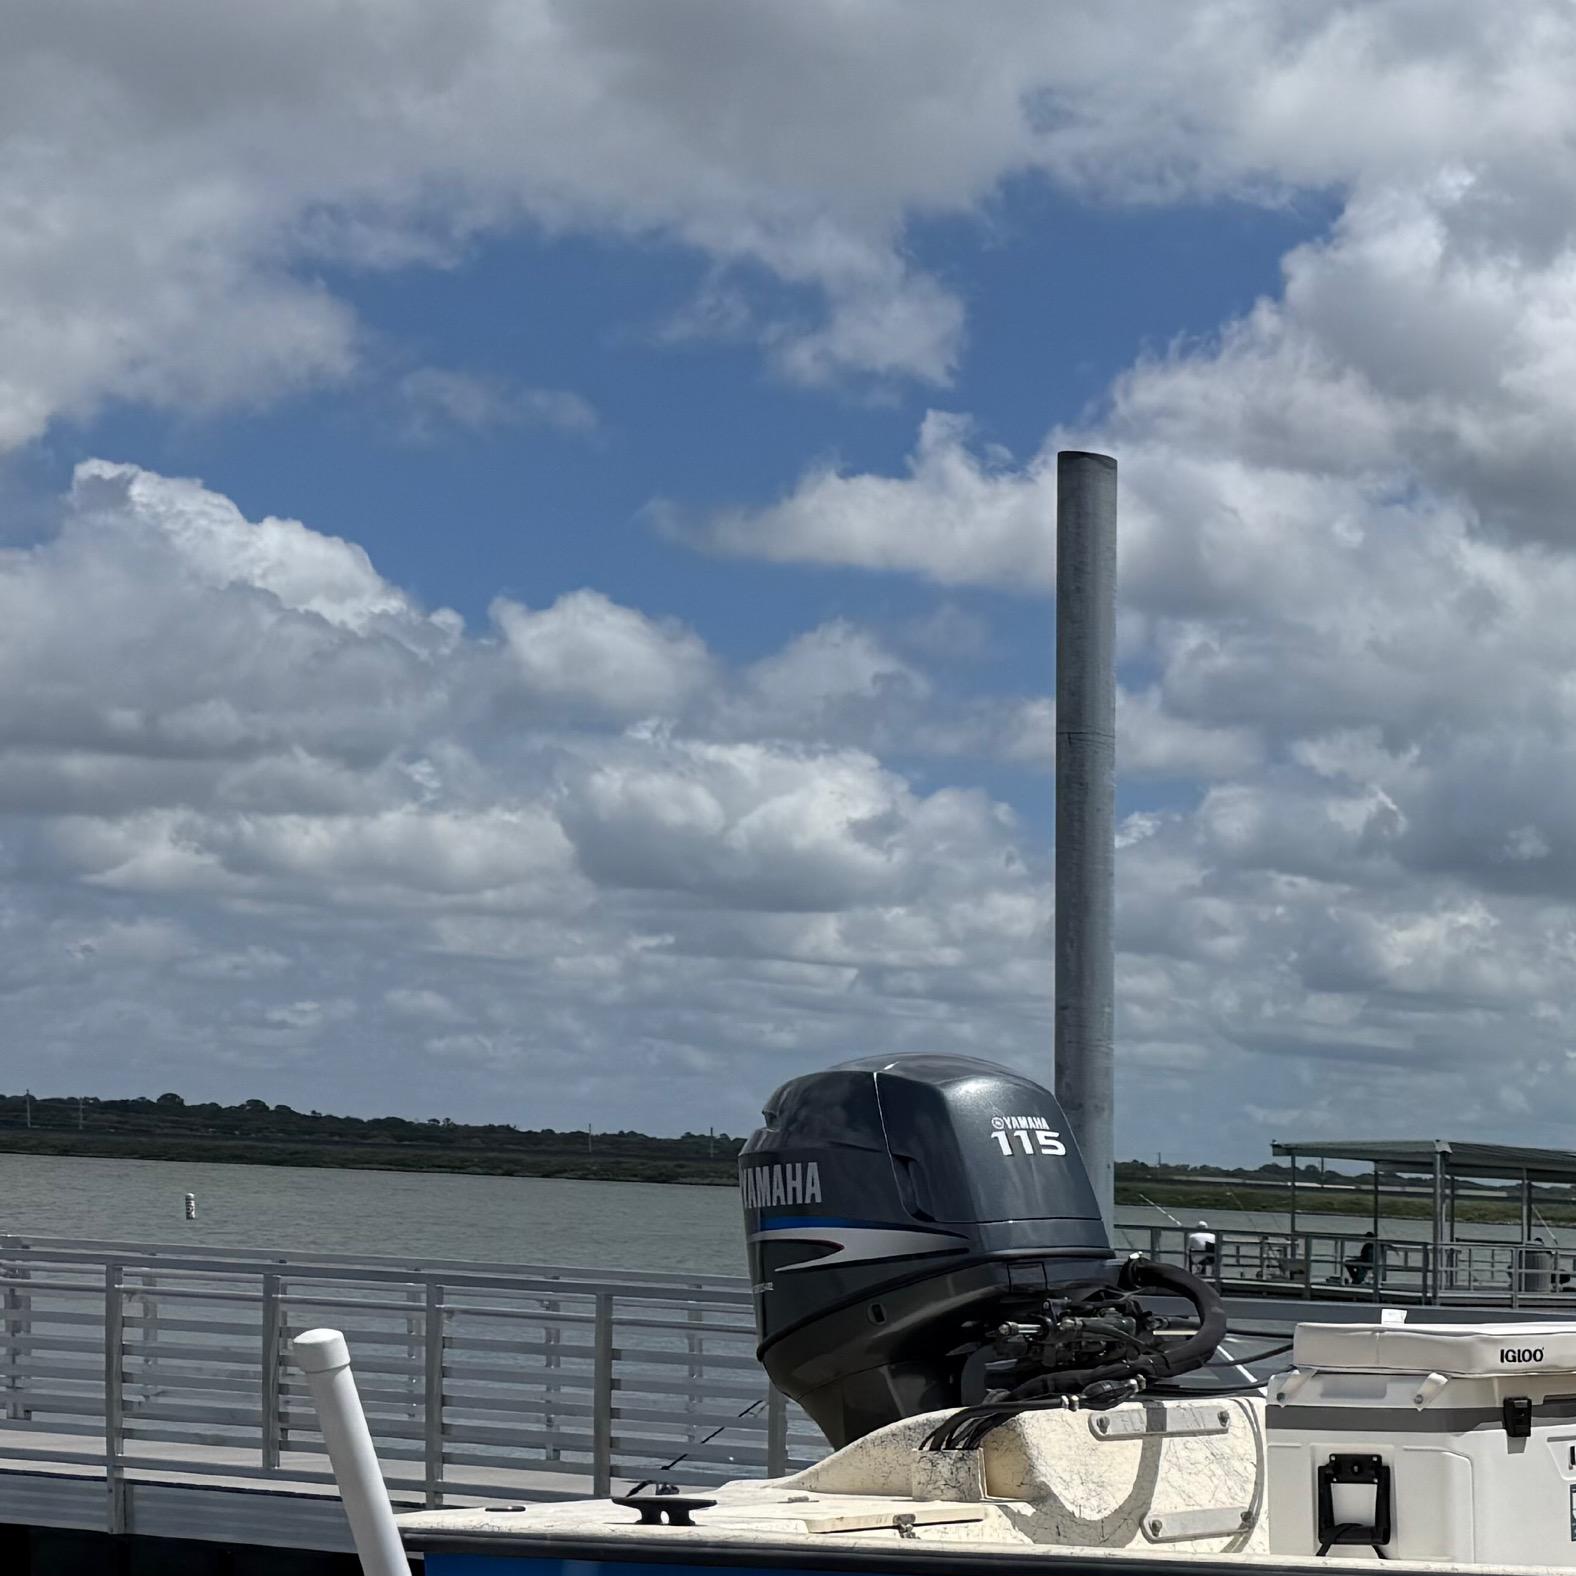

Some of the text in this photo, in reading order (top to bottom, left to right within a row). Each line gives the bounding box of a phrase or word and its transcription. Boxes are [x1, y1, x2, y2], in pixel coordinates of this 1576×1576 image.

[1003, 1116, 1050, 1129] YAMAHA
[991, 1130, 1066, 1156] 115
[739, 1162, 822, 1208] YAMAHA
[1500, 1348, 1544, 1363] IGLOO
